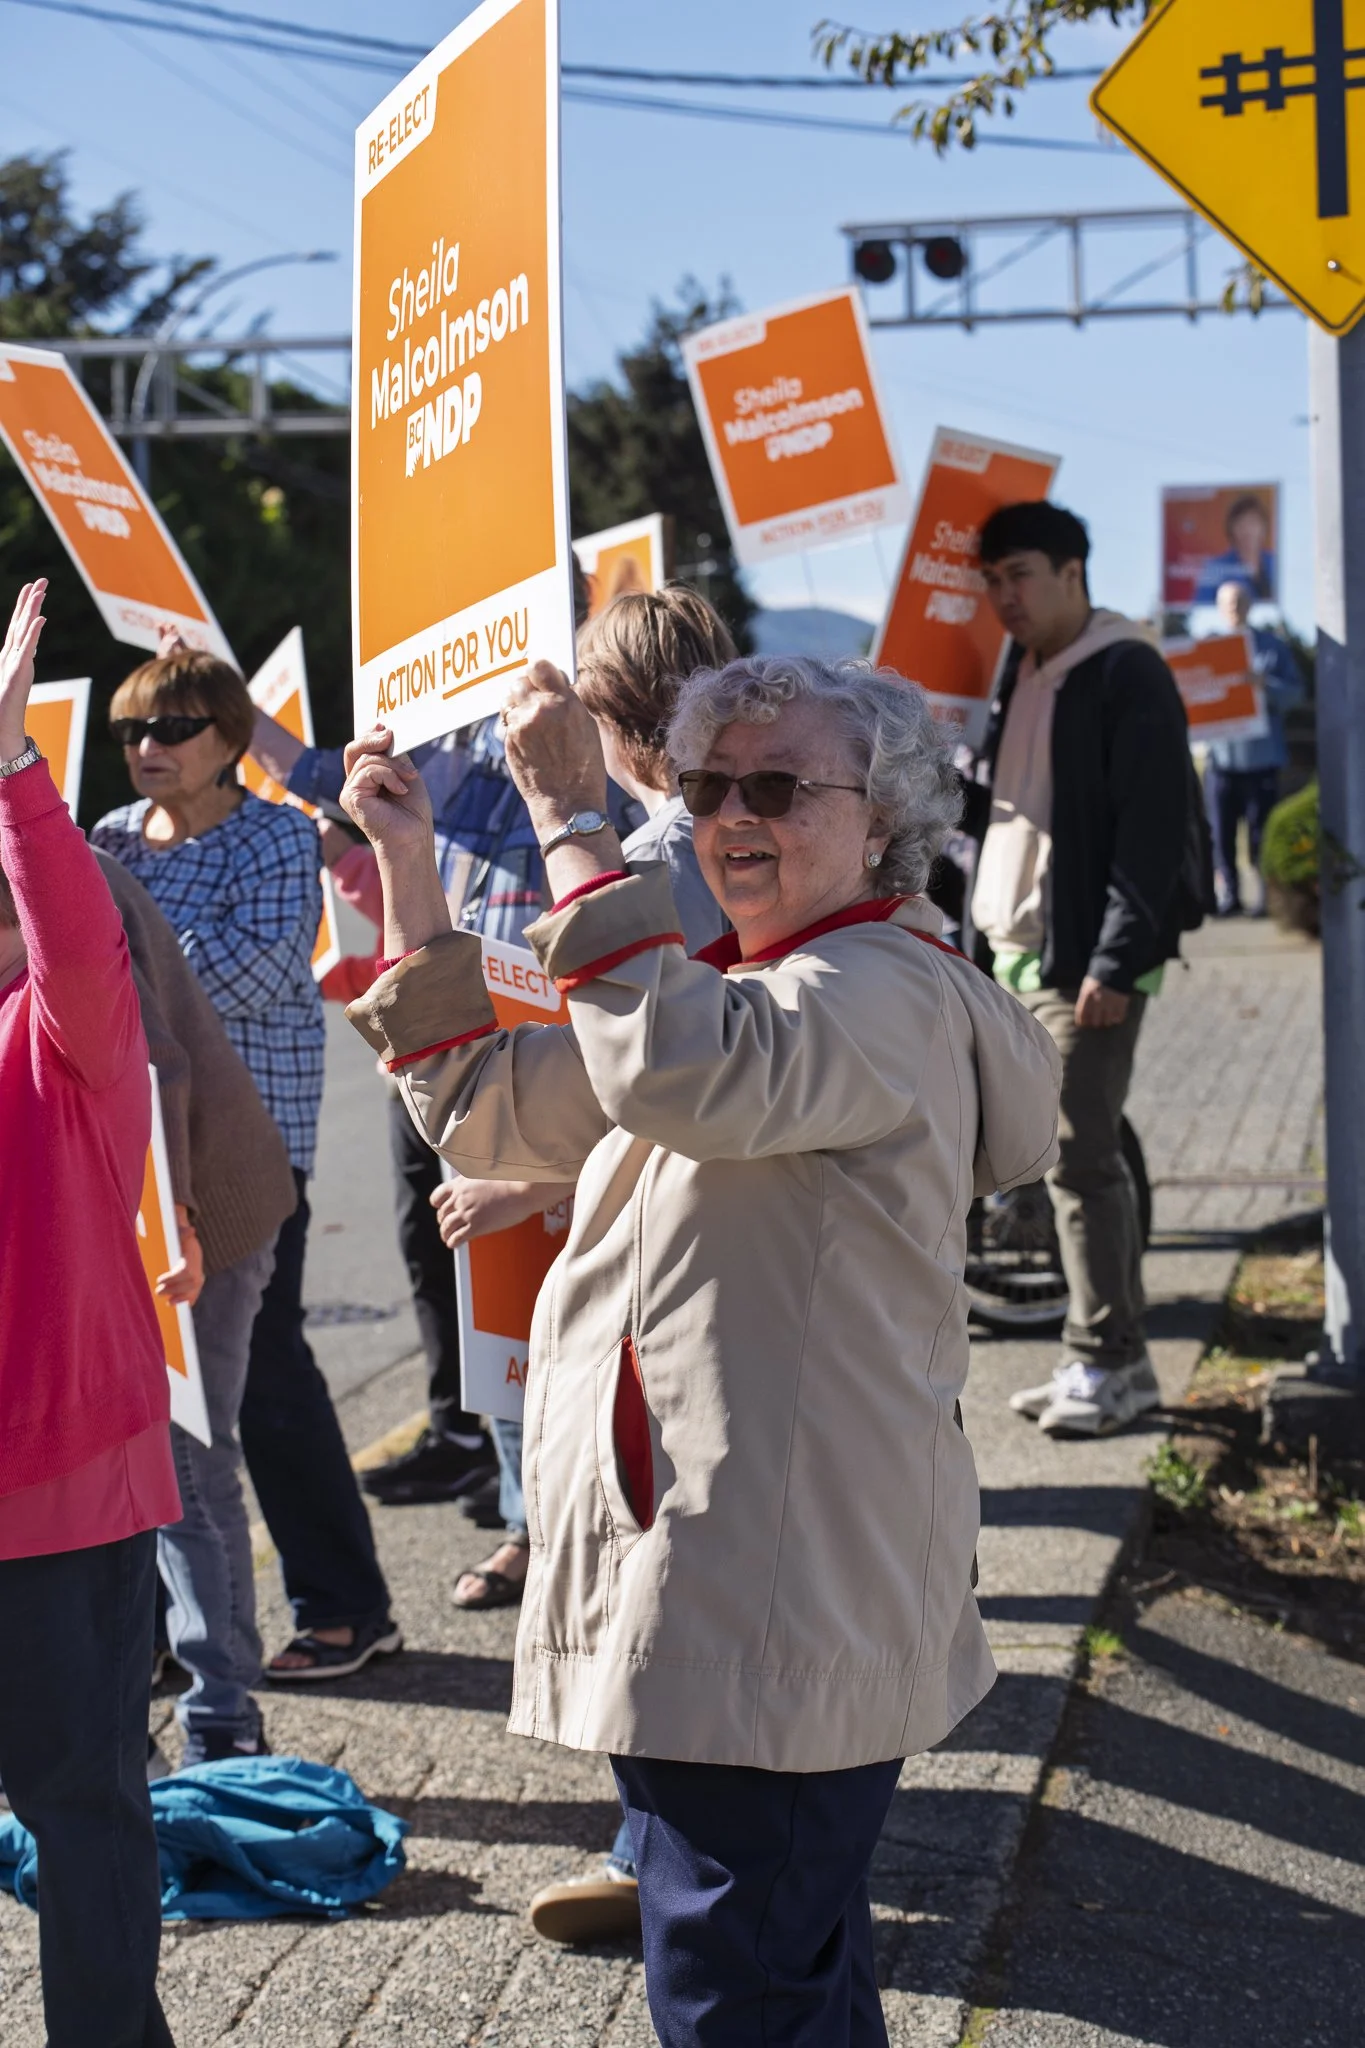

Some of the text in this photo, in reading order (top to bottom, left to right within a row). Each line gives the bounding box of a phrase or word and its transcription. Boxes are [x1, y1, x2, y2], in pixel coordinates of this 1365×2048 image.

[368, 85, 430, 175] RE-ELECT
[386, 236, 460, 341] Sheila
[371, 273, 529, 430] Malcolmson
[734, 376, 802, 415] Sheila
[409, 371, 482, 469] BC NDP
[723, 387, 865, 447] Malcolmson
[376, 607, 528, 718] ACTION FOR YOU
